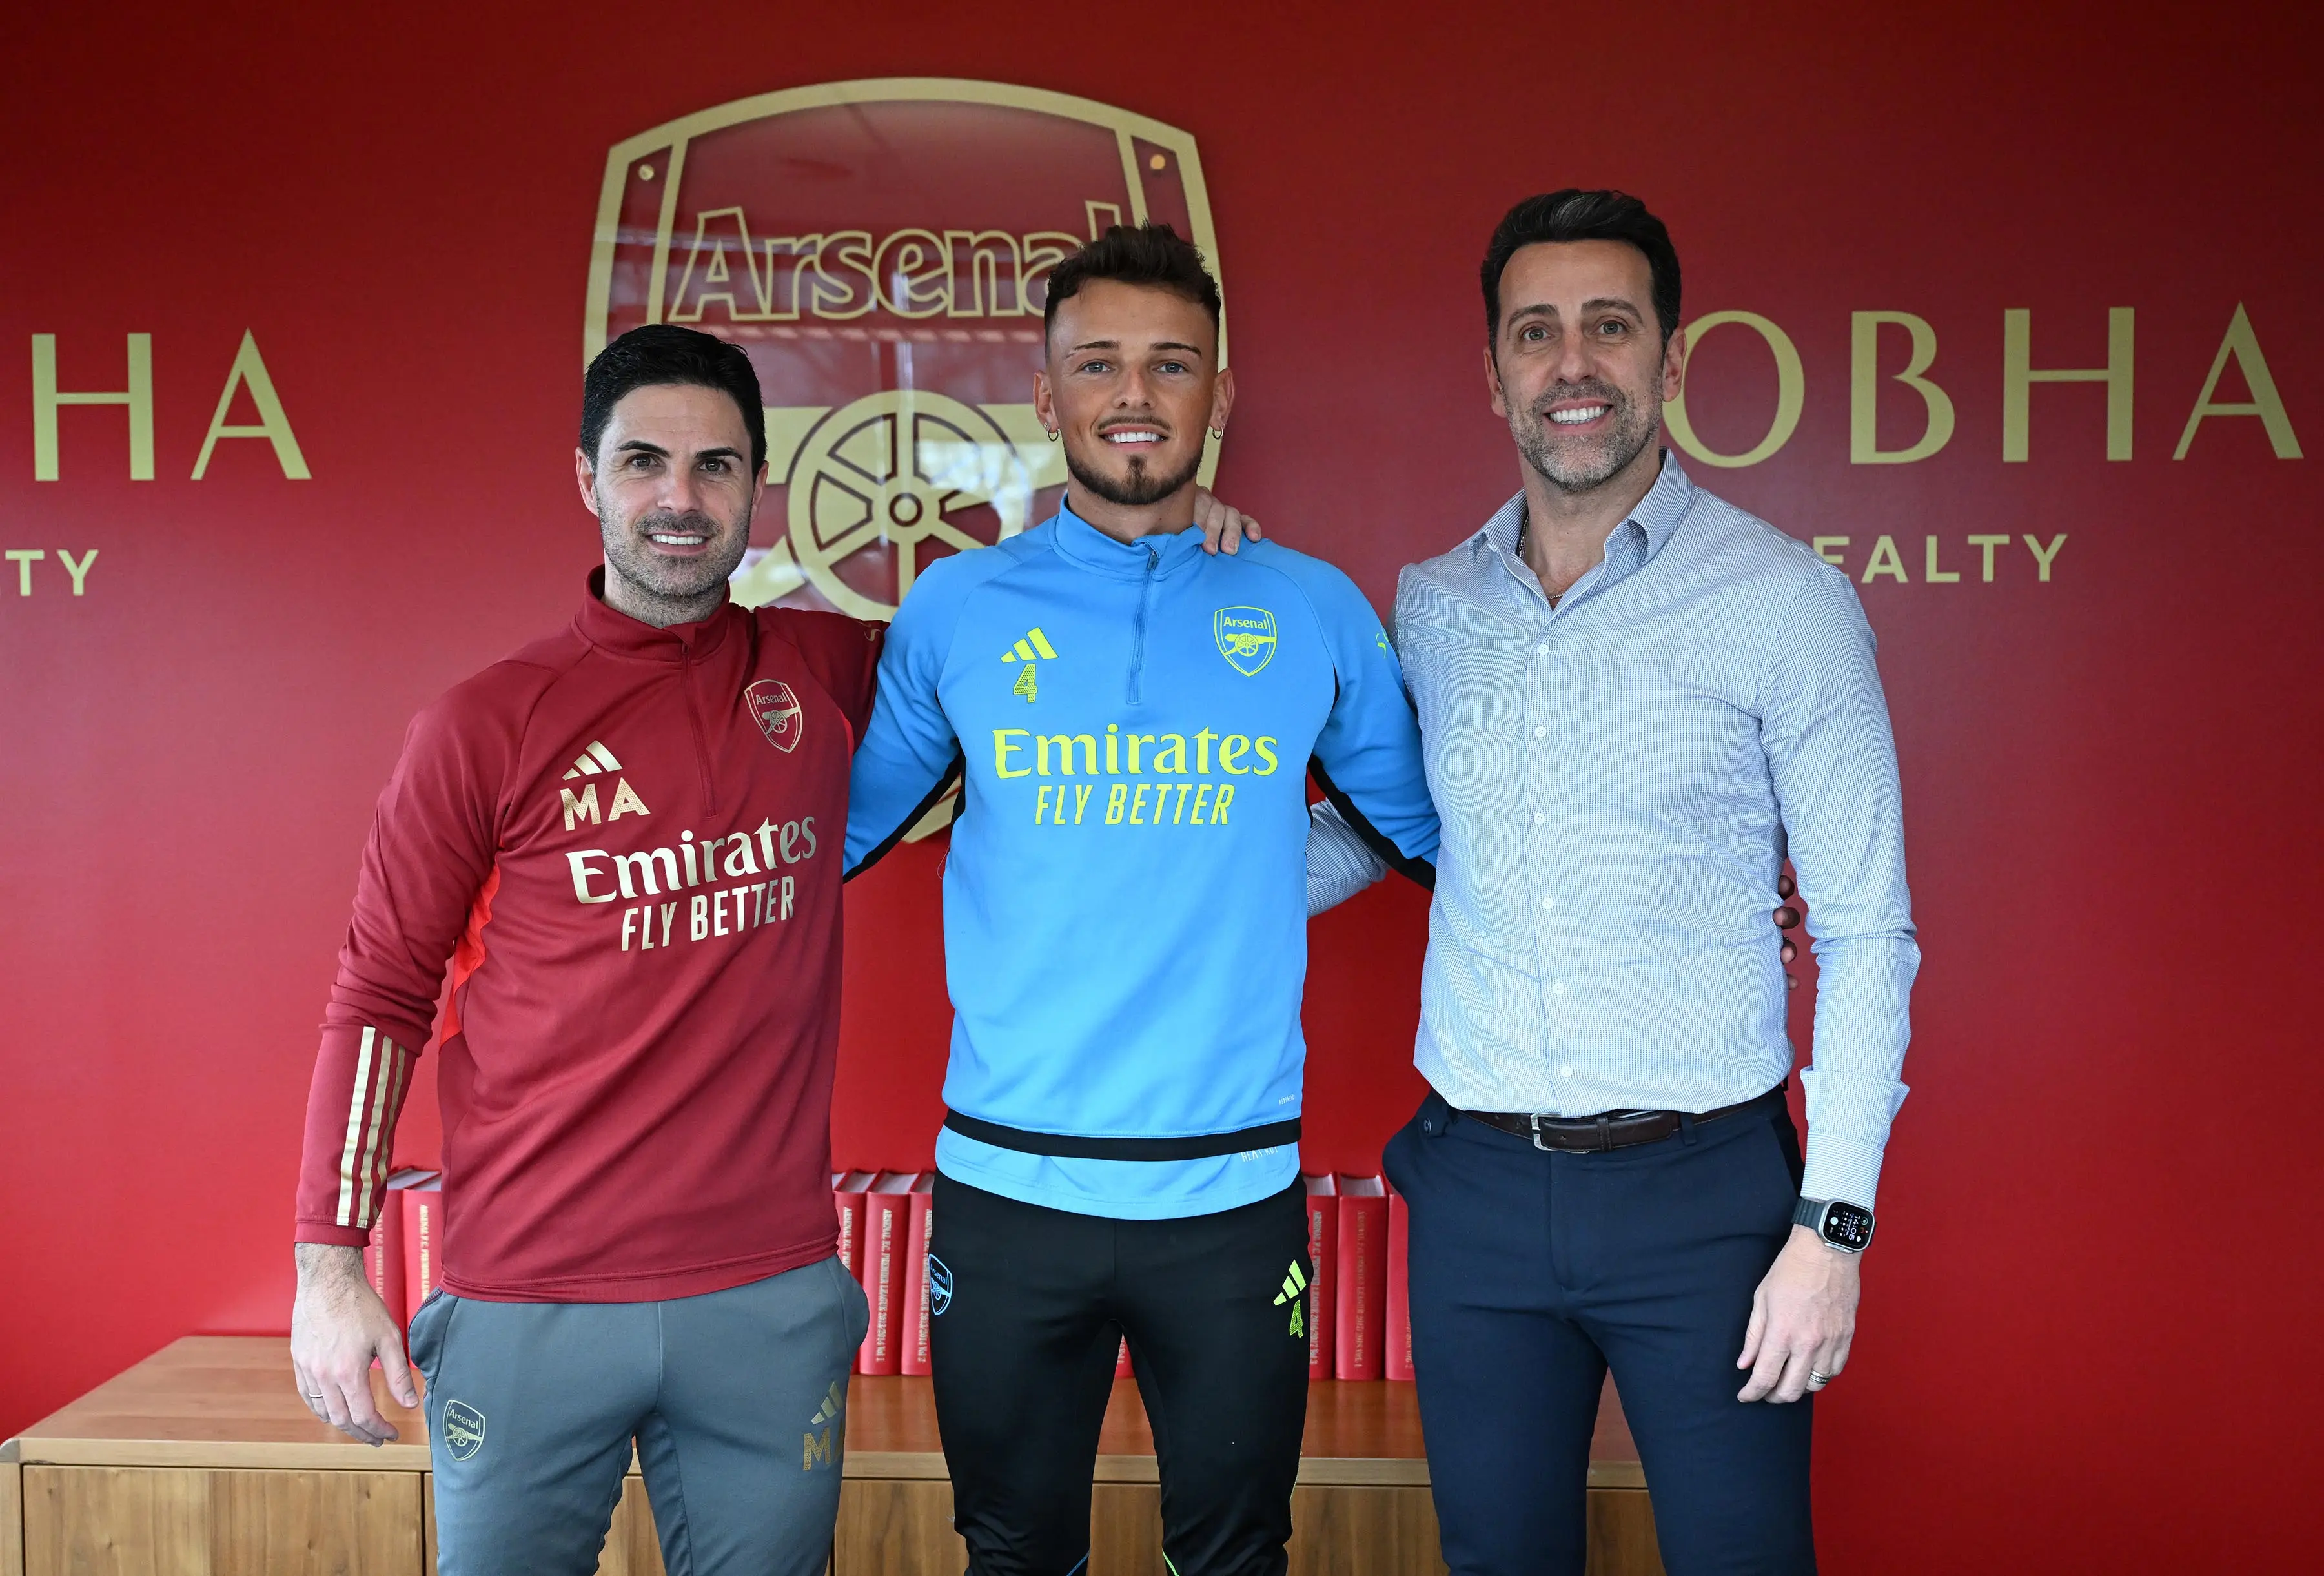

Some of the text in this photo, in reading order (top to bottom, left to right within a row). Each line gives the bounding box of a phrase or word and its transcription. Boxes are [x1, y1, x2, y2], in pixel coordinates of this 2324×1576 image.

[1223, 615, 1268, 631] Arsenal
[755, 691, 787, 708] Arsenal
[1013, 663, 1037, 704] 4
[992, 723, 1278, 779] Emirates
[560, 777, 651, 832] MA
[1035, 783, 1236, 825] FLY BETTER
[565, 815, 817, 905] Emirates
[621, 875, 795, 952] FLY BETTER
[881, 1209, 892, 1240] ARSENAL
[1848, 1216, 1860, 1240] 14:05
[1289, 1299, 1303, 1339] 4
[449, 1409, 478, 1429] Arsenal
